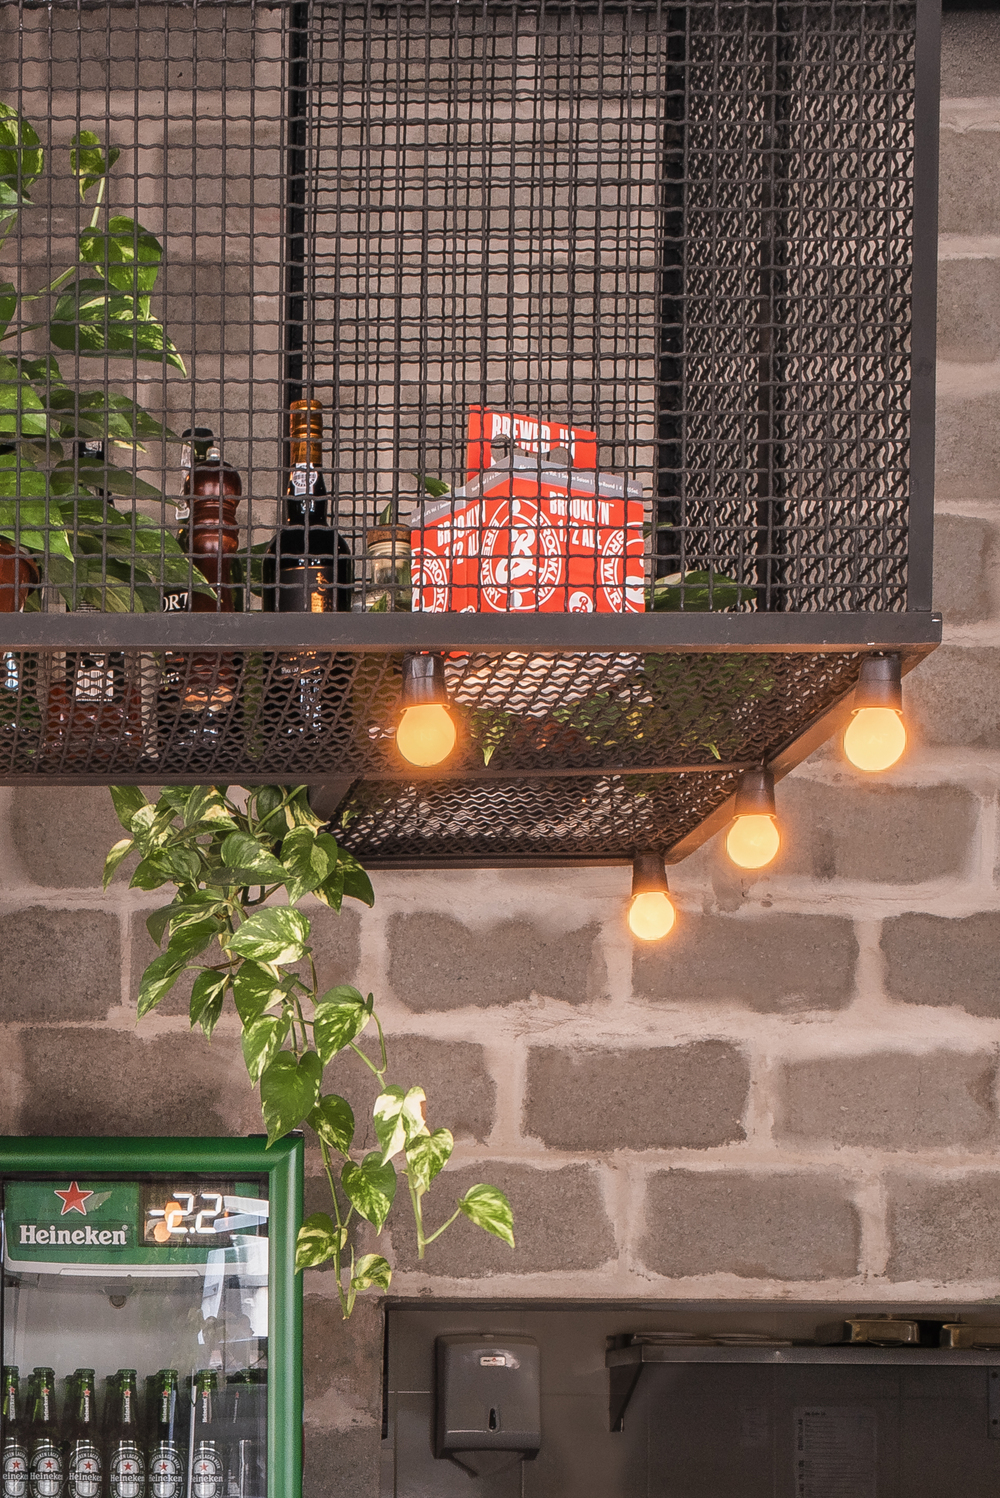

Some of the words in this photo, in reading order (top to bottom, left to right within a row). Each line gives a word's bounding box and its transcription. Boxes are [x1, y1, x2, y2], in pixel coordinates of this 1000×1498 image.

[492, 414, 551, 454] BREWED
[559, 428, 576, 460] IN
[581, 524, 602, 550] ALE
[19, 1225, 128, 1245] Heineken
[192, 1475, 224, 1483] eineken
